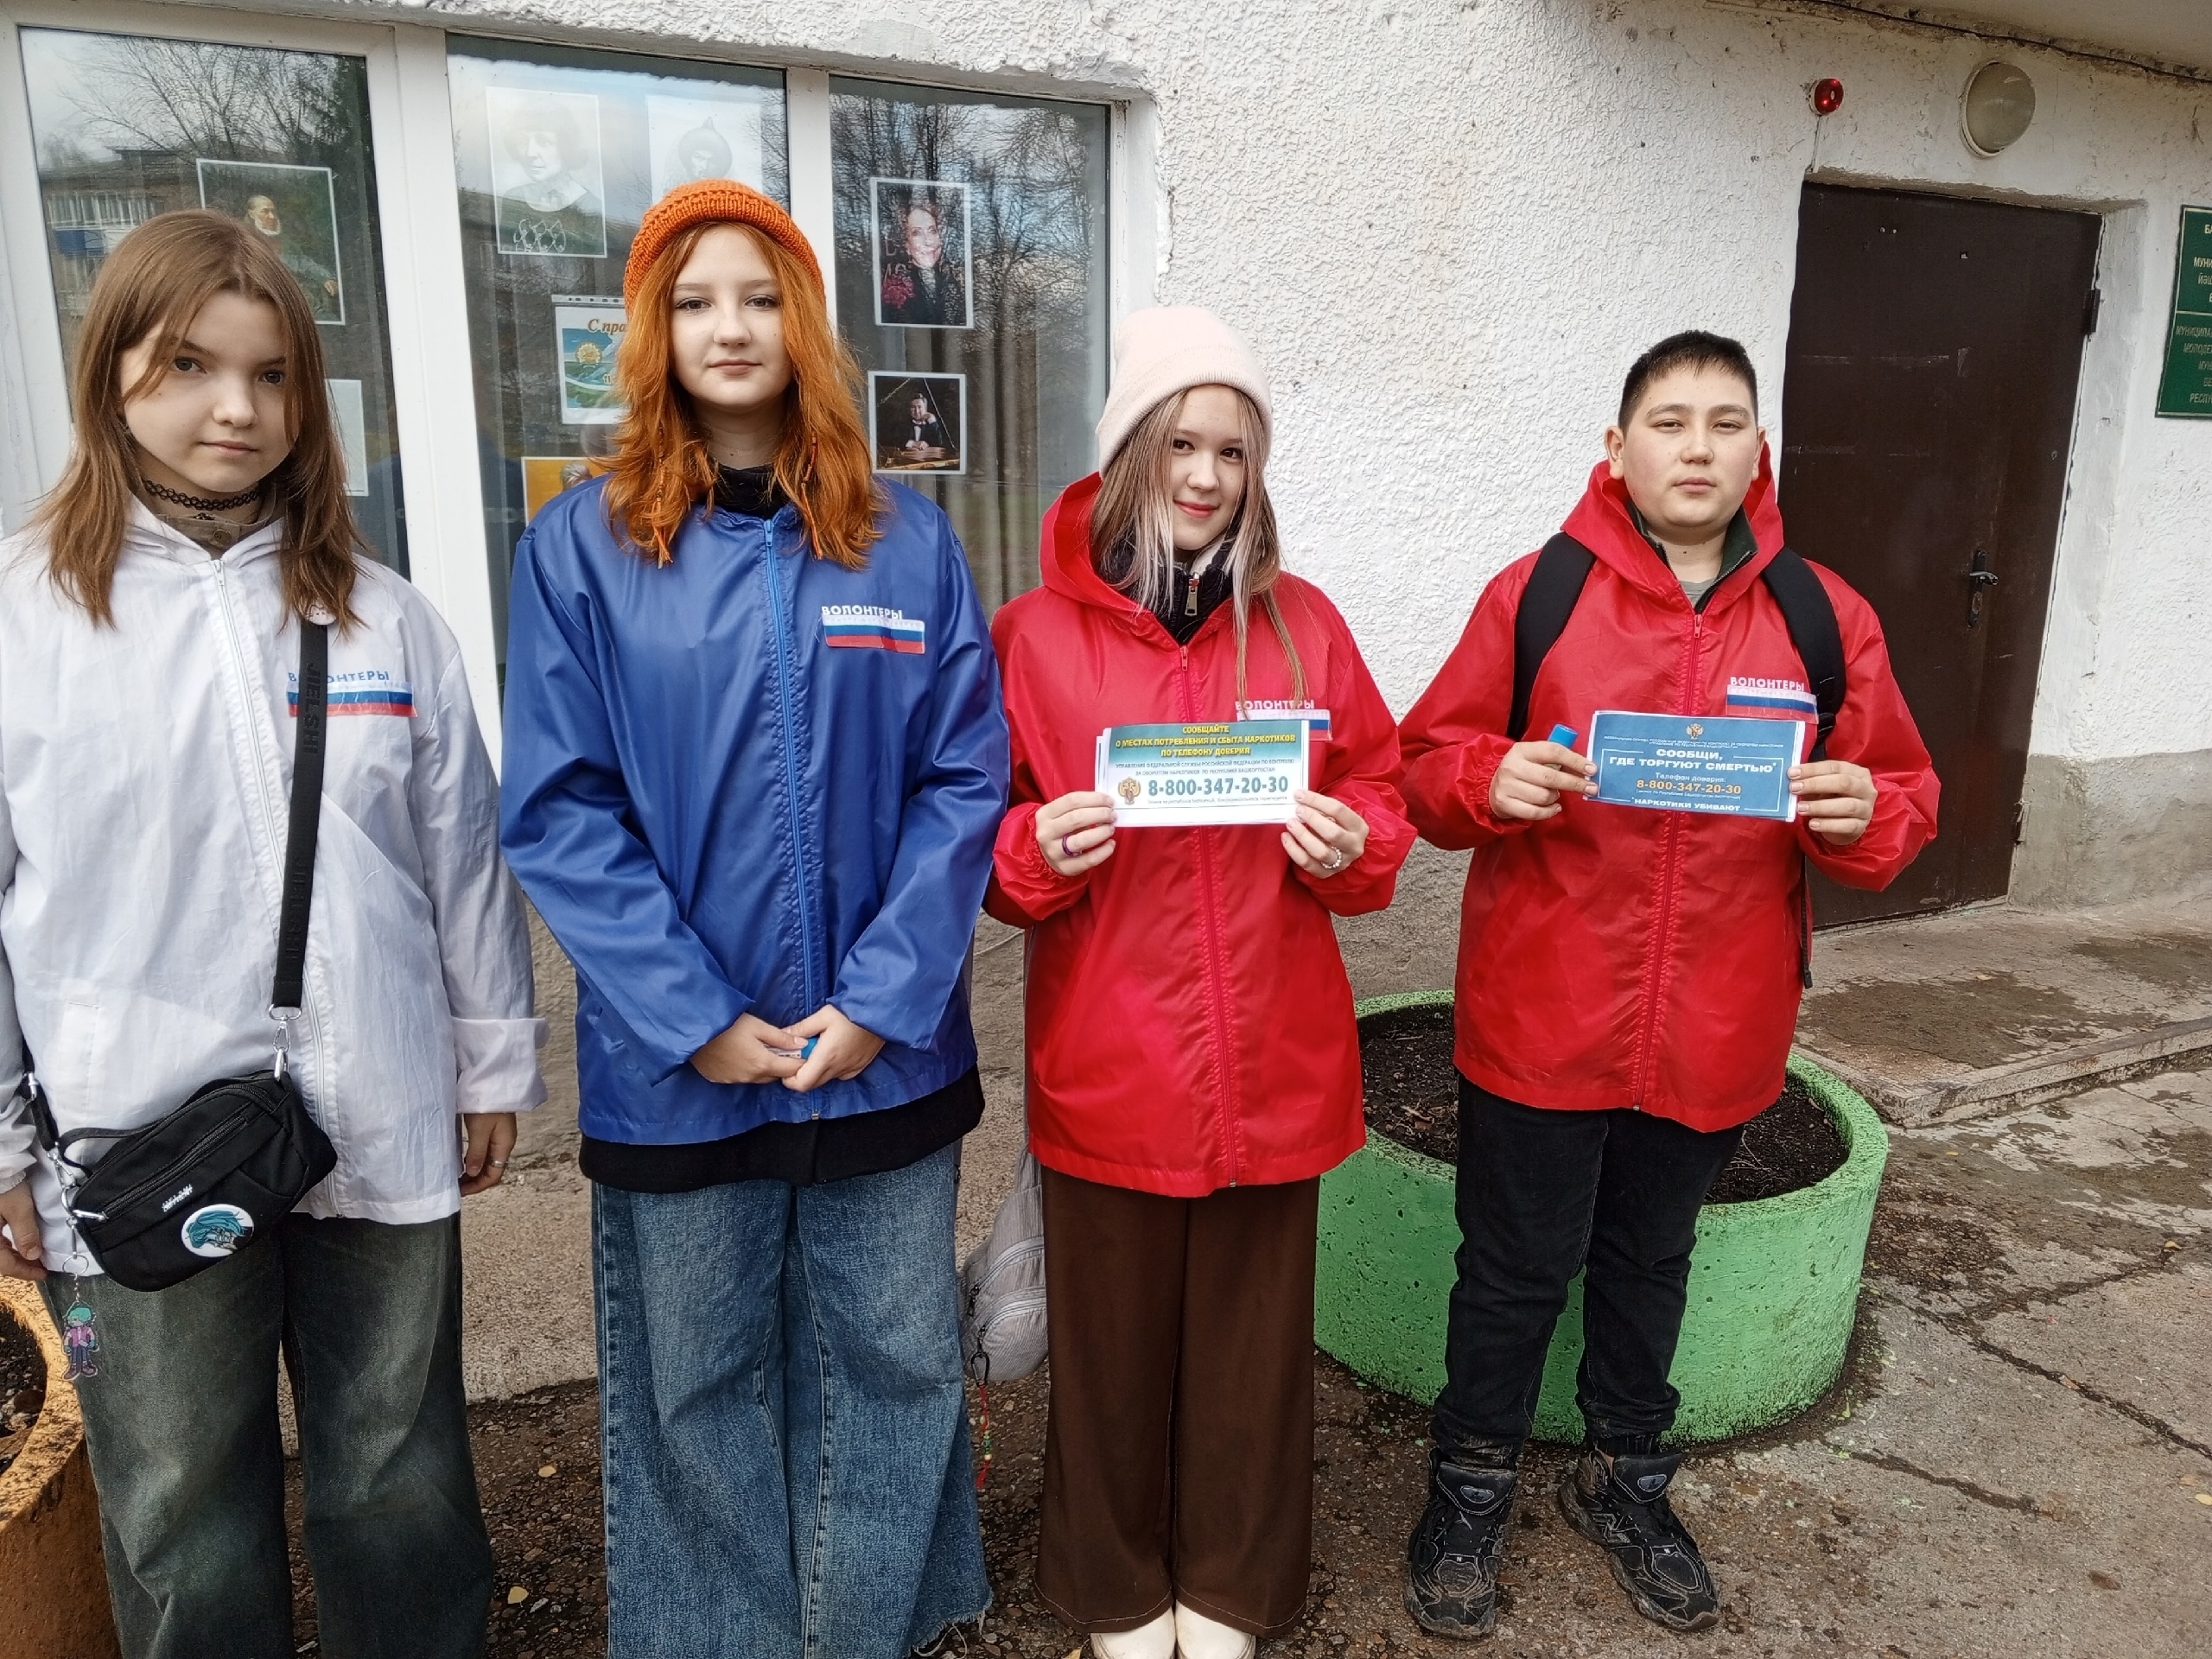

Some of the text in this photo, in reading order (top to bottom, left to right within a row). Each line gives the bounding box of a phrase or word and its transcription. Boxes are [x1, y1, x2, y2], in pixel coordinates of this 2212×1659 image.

[588, 318, 599, 332] С
[822, 605, 903, 620] ВОЛОНТЕРЫ
[288, 671, 389, 683] ВОНТЕРЫ
[1730, 677, 1805, 691] ВОЛОНТЕРЫ
[1182, 724, 1230, 734] СООБЩАЙТЕ
[1122, 738, 1154, 747] МЕСТАХ
[1154, 737, 1209, 746] ПОТРЕБЛЕНИЯ
[1217, 735, 1243, 744] СБЫТА
[1244, 734, 1296, 743] НАРКОТИКОВ
[1173, 747, 1213, 757] ТЕЛЕФОНУ
[1215, 747, 1250, 756] ДОВЕРИЯ
[1656, 748, 1723, 761] СООБЩИ,
[1609, 756, 1636, 766] ГДЕ
[1638, 758, 1702, 769] ТОРГУЮТ
[1656, 772, 1726, 784] Телефон доверия:
[1148, 776, 1288, 796] 8-800-347-20-30
[1636, 779, 1742, 794] 8-800-347-20-30
[1694, 803, 1741, 812] УБИВАЮТ
